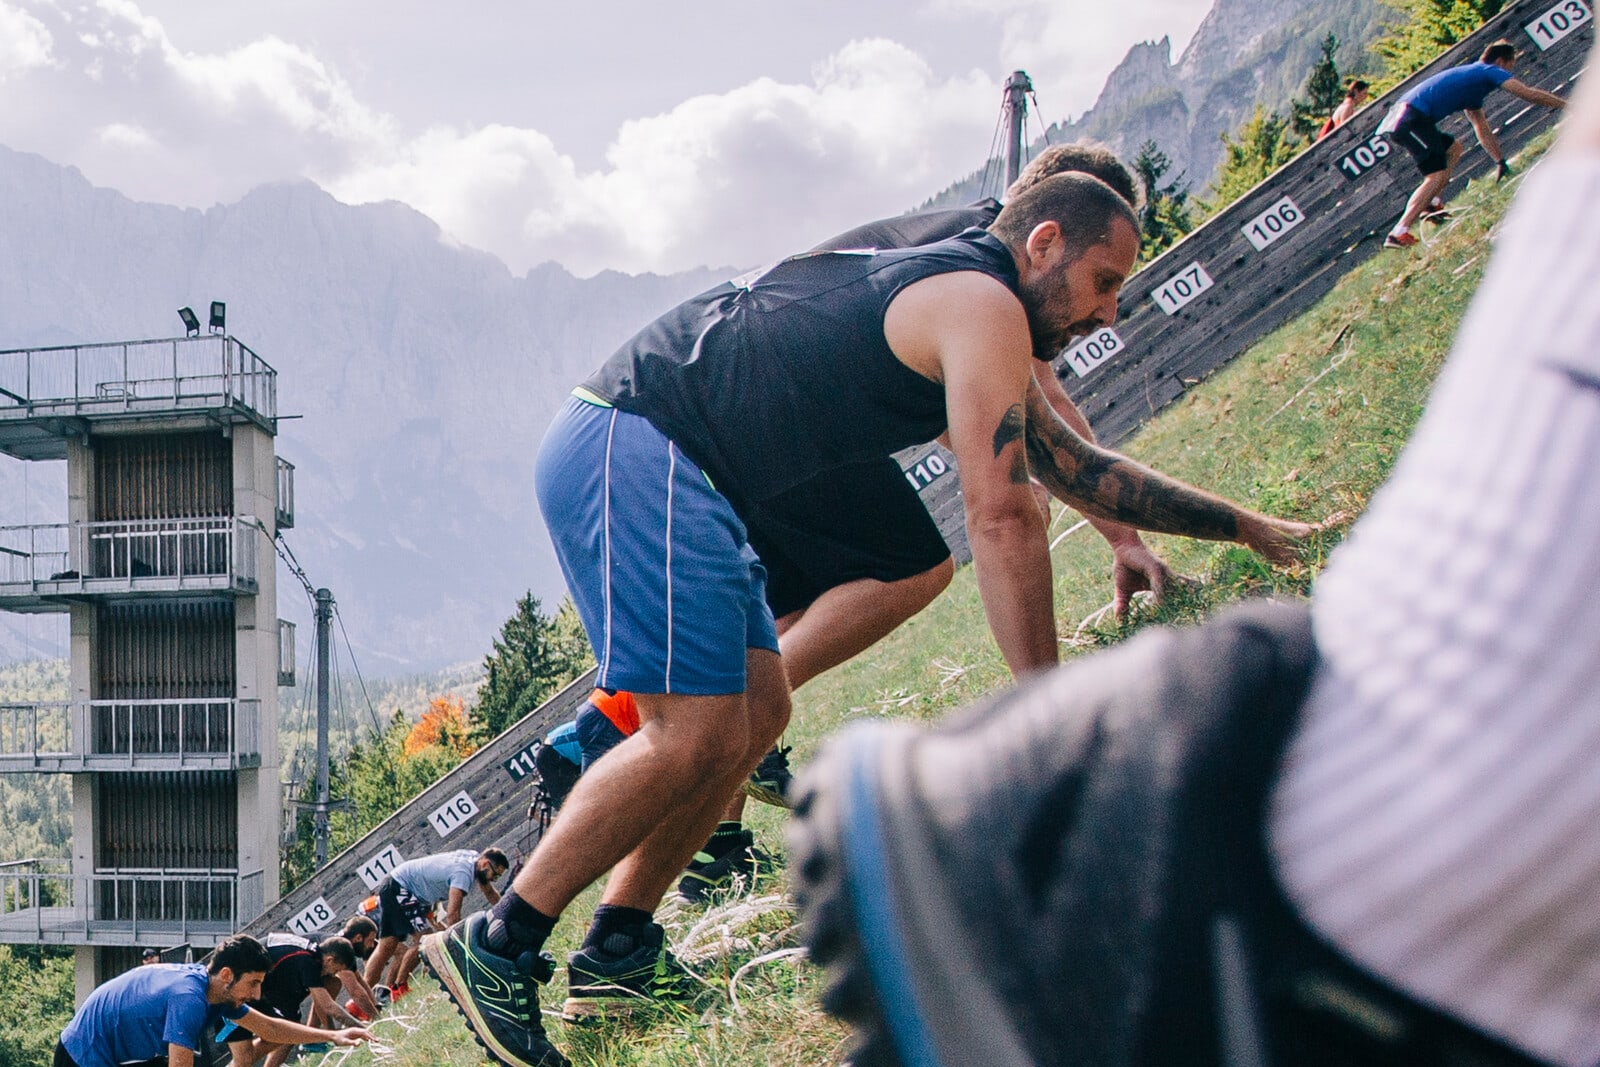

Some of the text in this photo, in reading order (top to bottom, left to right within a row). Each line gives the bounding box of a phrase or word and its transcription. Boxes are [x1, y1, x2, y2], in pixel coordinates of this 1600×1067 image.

[1536, 1, 1586, 40] 103
[1342, 135, 1391, 175] 105
[1252, 204, 1297, 241] 106
[1161, 268, 1202, 306] 107
[1074, 332, 1117, 368] 108
[435, 797, 471, 829] 116
[365, 850, 396, 882] 117
[295, 904, 329, 933] 118
